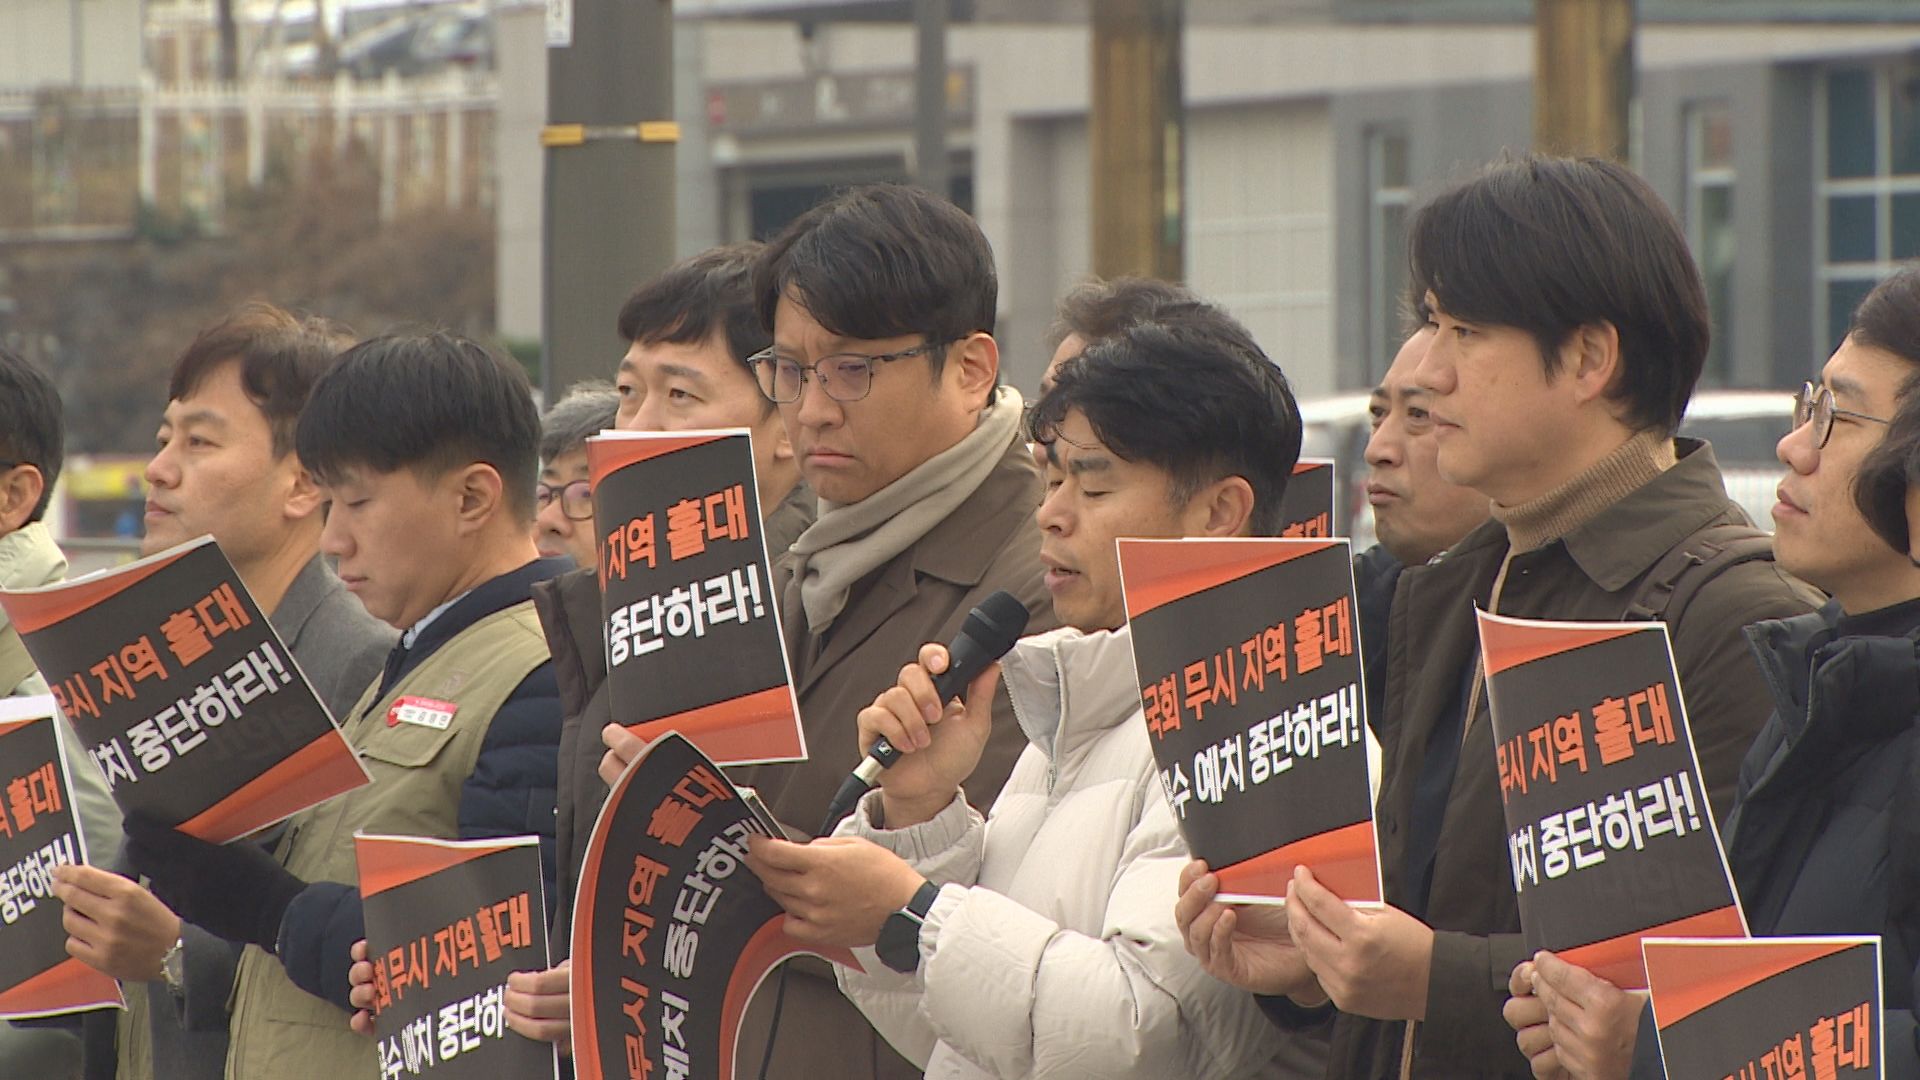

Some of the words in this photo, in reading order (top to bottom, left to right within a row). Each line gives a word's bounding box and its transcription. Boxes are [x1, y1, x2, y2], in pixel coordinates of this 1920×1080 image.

[607, 513, 656, 580] 지역
[667, 484, 748, 563] 홀대
[90, 635, 168, 704] 지역
[160, 581, 251, 667] 홀대
[610, 563, 765, 667] 중단하라!
[1184, 647, 1236, 720] 무시
[1241, 622, 1287, 692] 지역
[1294, 596, 1352, 675] 홀대
[88, 737, 138, 792] 치
[126, 641, 292, 773] 중단하라!
[1194, 733, 1245, 803] 예치
[1249, 684, 1360, 785] 중단하라!
[1528, 711, 1589, 783] 지역
[1592, 682, 1676, 766] 홀대
[6, 761, 63, 832] 홀대
[1509, 825, 1538, 892] 치
[1541, 771, 1701, 879] 중단하라!
[622, 854, 670, 965] 지역
[646, 764, 733, 848] 홀대
[388, 936, 429, 1000] 무시
[434, 917, 479, 977] 지역
[476, 892, 531, 962] 홀대
[438, 984, 509, 1061] 중단하
[1809, 1001, 1870, 1080] 홀대
